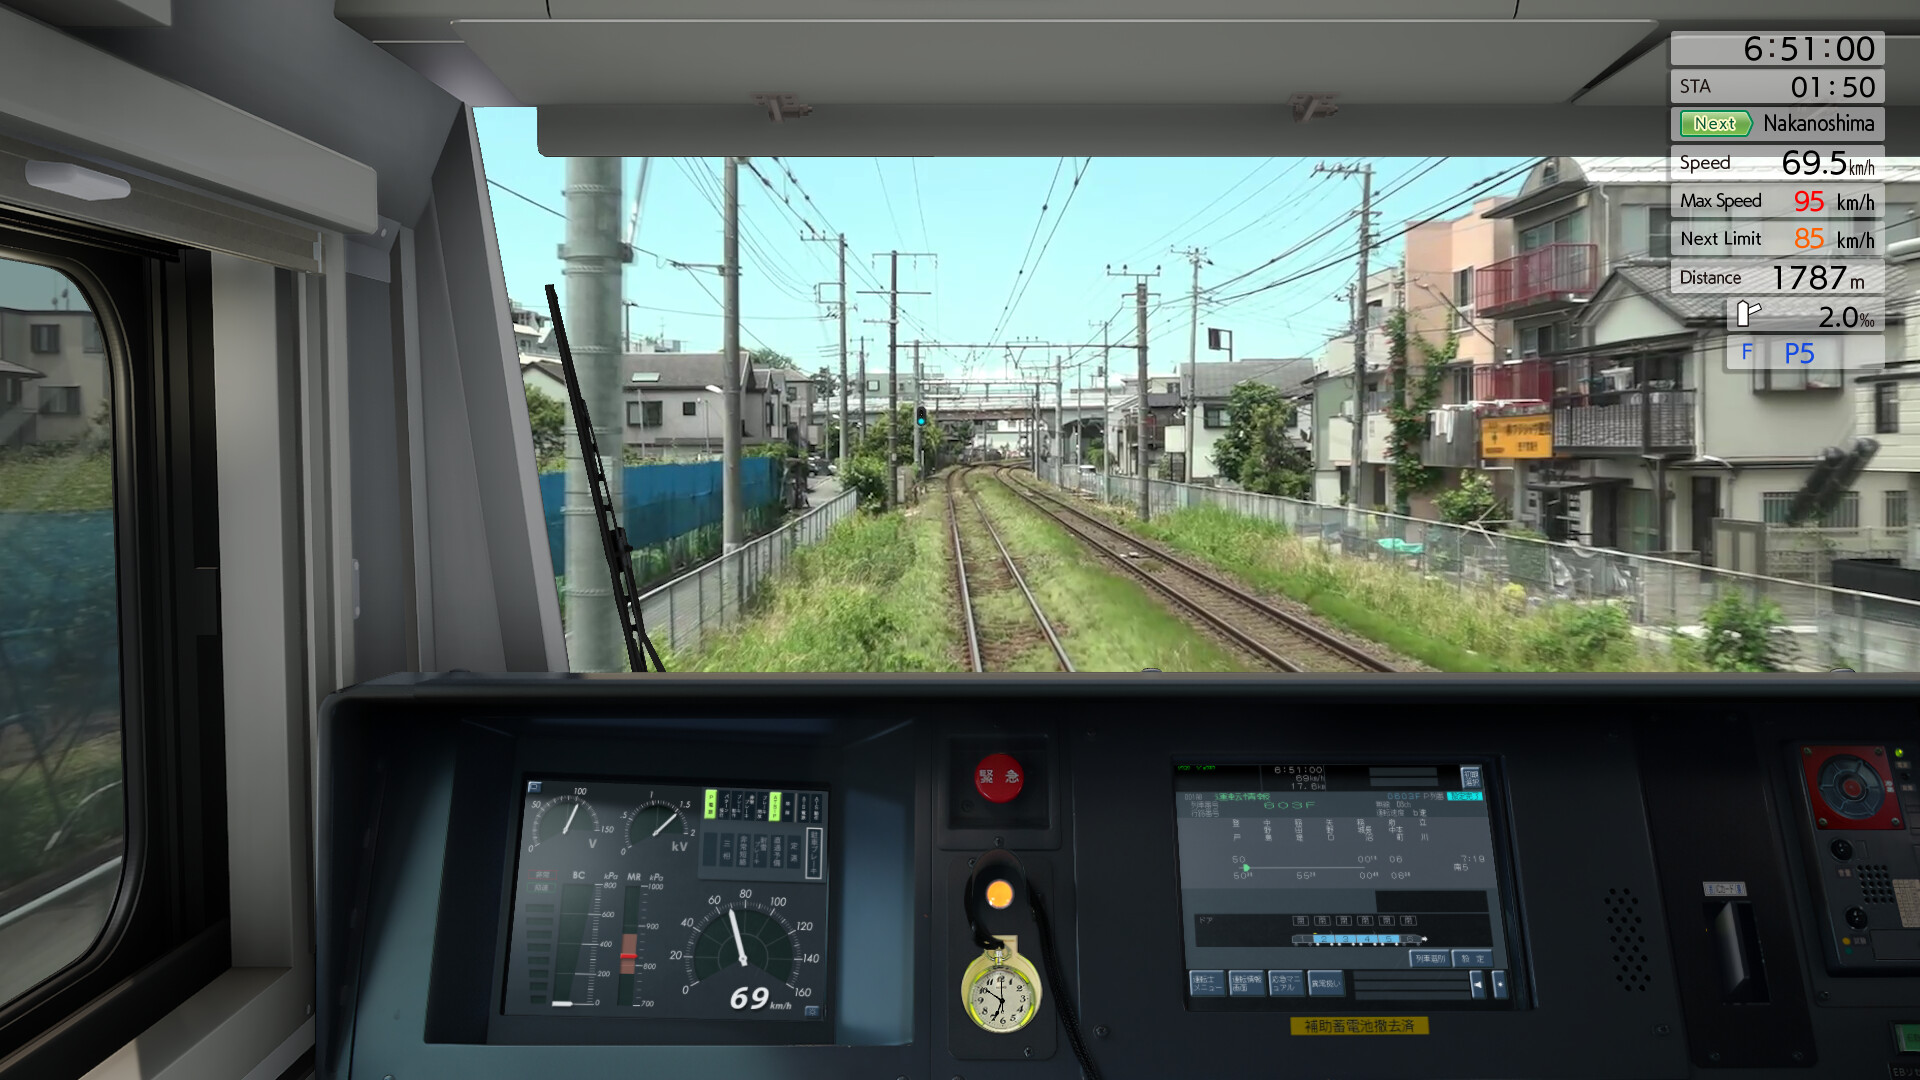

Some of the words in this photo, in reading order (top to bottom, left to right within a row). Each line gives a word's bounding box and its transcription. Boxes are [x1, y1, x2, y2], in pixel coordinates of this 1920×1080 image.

[1274, 766, 1322, 774] 6:51:00
[574, 787, 587, 795] 100
[589, 839, 597, 848] V
[671, 841, 688, 852] kV
[572, 871, 586, 880] BC
[604, 872, 618, 880] kPa
[627, 873, 641, 881] MR
[649, 873, 664, 882] kPa
[739, 889, 752, 898] 80
[708, 895, 721, 905] 60
[770, 897, 787, 907] 100
[681, 918, 694, 927] 40
[797, 922, 813, 931] 120
[669, 951, 682, 960] 20
[803, 954, 820, 963] 140
[683, 986, 689, 994] 0
[795, 988, 811, 997] 160
[730, 987, 770, 1010] 69
[770, 1001, 792, 1010] km/h
[641, 1000, 654, 1008] 700
[982, 1007, 988, 1015] 8
[1017, 1005, 1024, 1013] 4
[1305, 1019, 1414, 1033] 補助蓄電池撤去済
